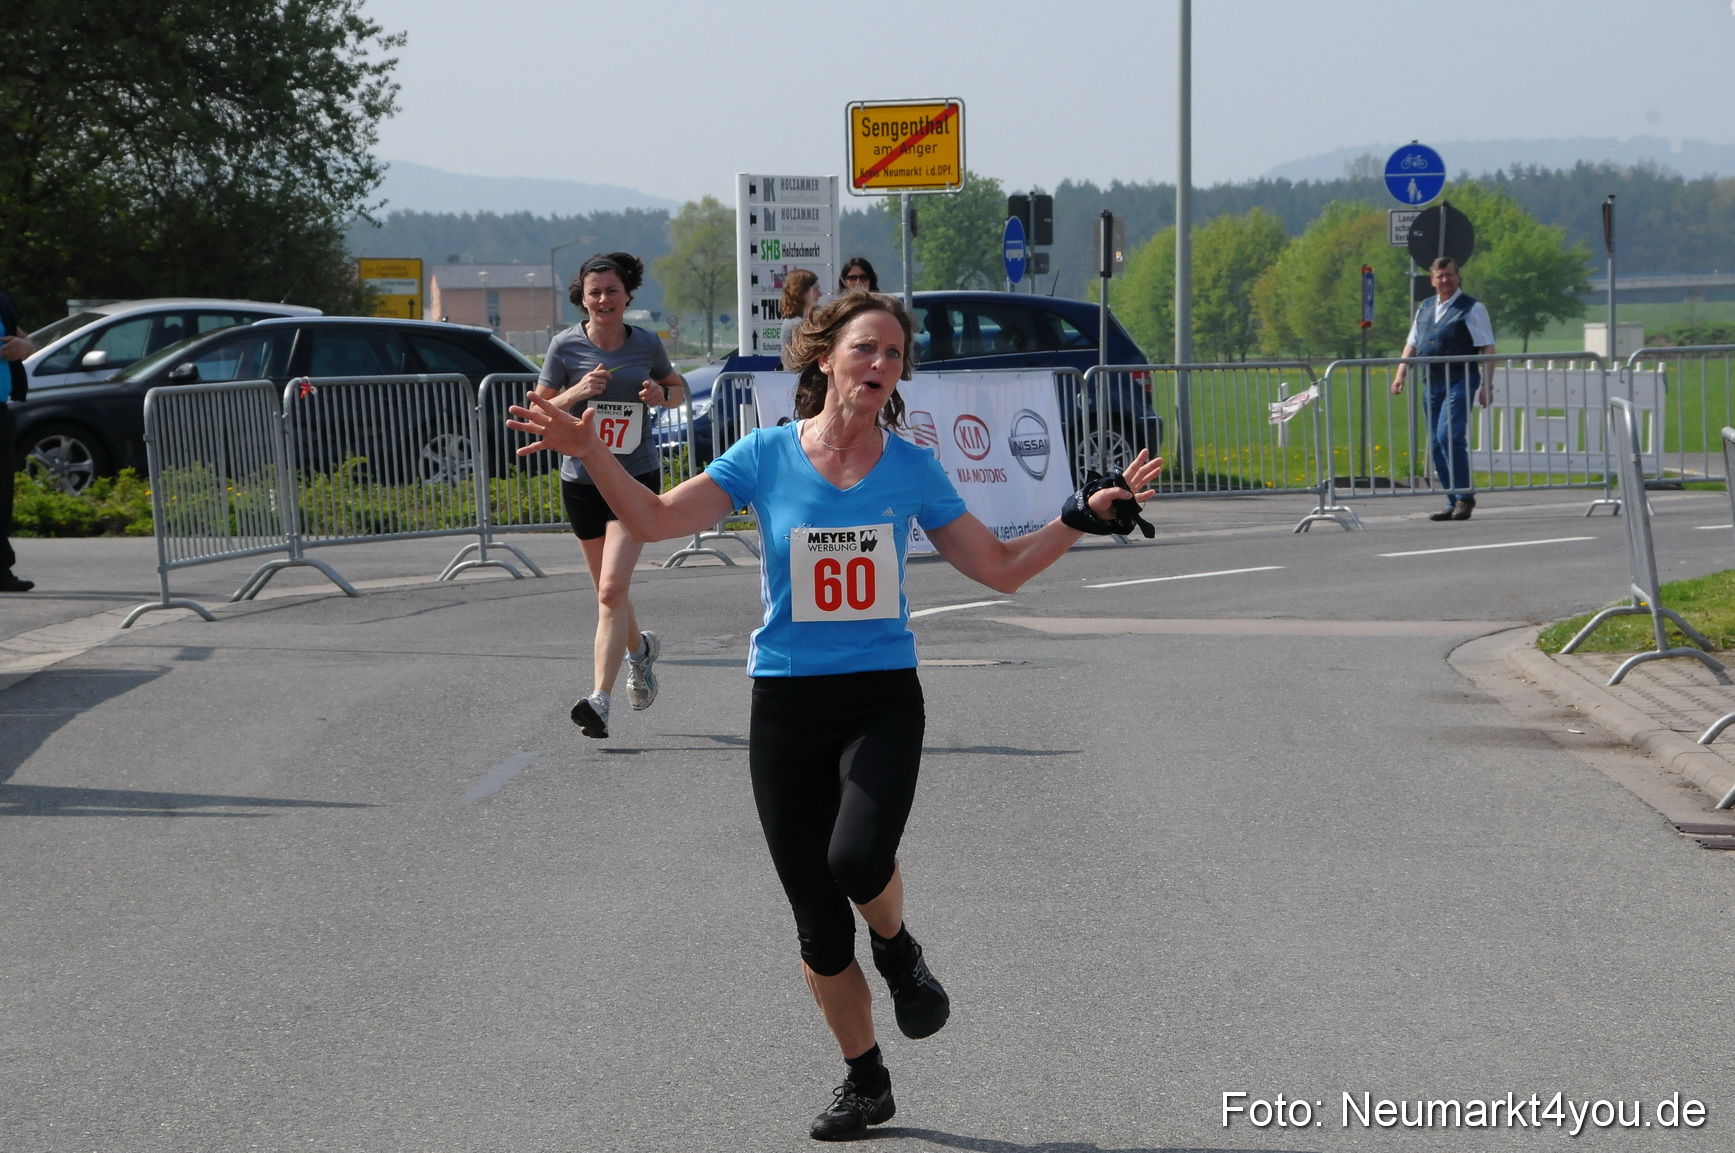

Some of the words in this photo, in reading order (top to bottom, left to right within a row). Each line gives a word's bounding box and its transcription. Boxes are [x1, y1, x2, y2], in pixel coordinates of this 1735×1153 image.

[862, 115, 949, 142] Sengenthal
[873, 145, 893, 155] am
[899, 142, 938, 157] Anger
[883, 166, 922, 177] Neumarkt
[780, 178, 819, 191] HOLZAMMER
[781, 207, 820, 221] HOLZAMMER
[1398, 214, 1415, 223] Land
[760, 239, 781, 262] SHB
[781, 242, 820, 258] Holzfachmarkt
[760, 298, 782, 320] THU
[762, 327, 782, 339] HEIDE
[600, 418, 630, 448] 67
[959, 425, 986, 450] KIA
[957, 468, 972, 483] KIA
[972, 468, 1008, 483] MOTORS
[807, 531, 856, 543] MEYER
[808, 543, 857, 552] WERBUNG
[814, 556, 876, 612] 60
